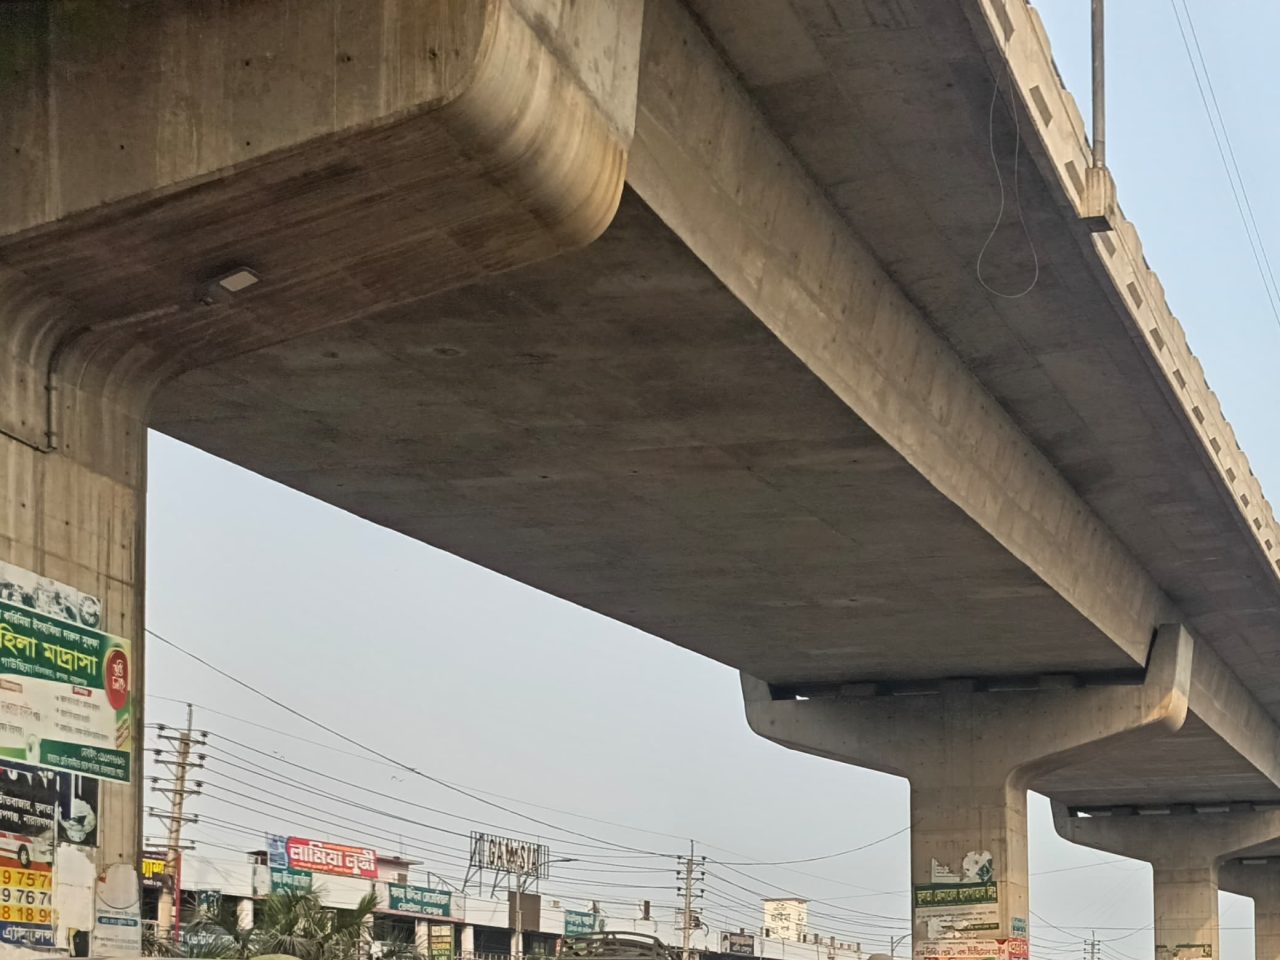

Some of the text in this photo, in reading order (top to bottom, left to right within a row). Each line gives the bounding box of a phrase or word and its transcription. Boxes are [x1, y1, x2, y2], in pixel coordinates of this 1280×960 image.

[0, 624, 38, 659] হিলা
[41, 641, 98, 675] মাদ্রাসা
[16, 889, 35, 902] 76
